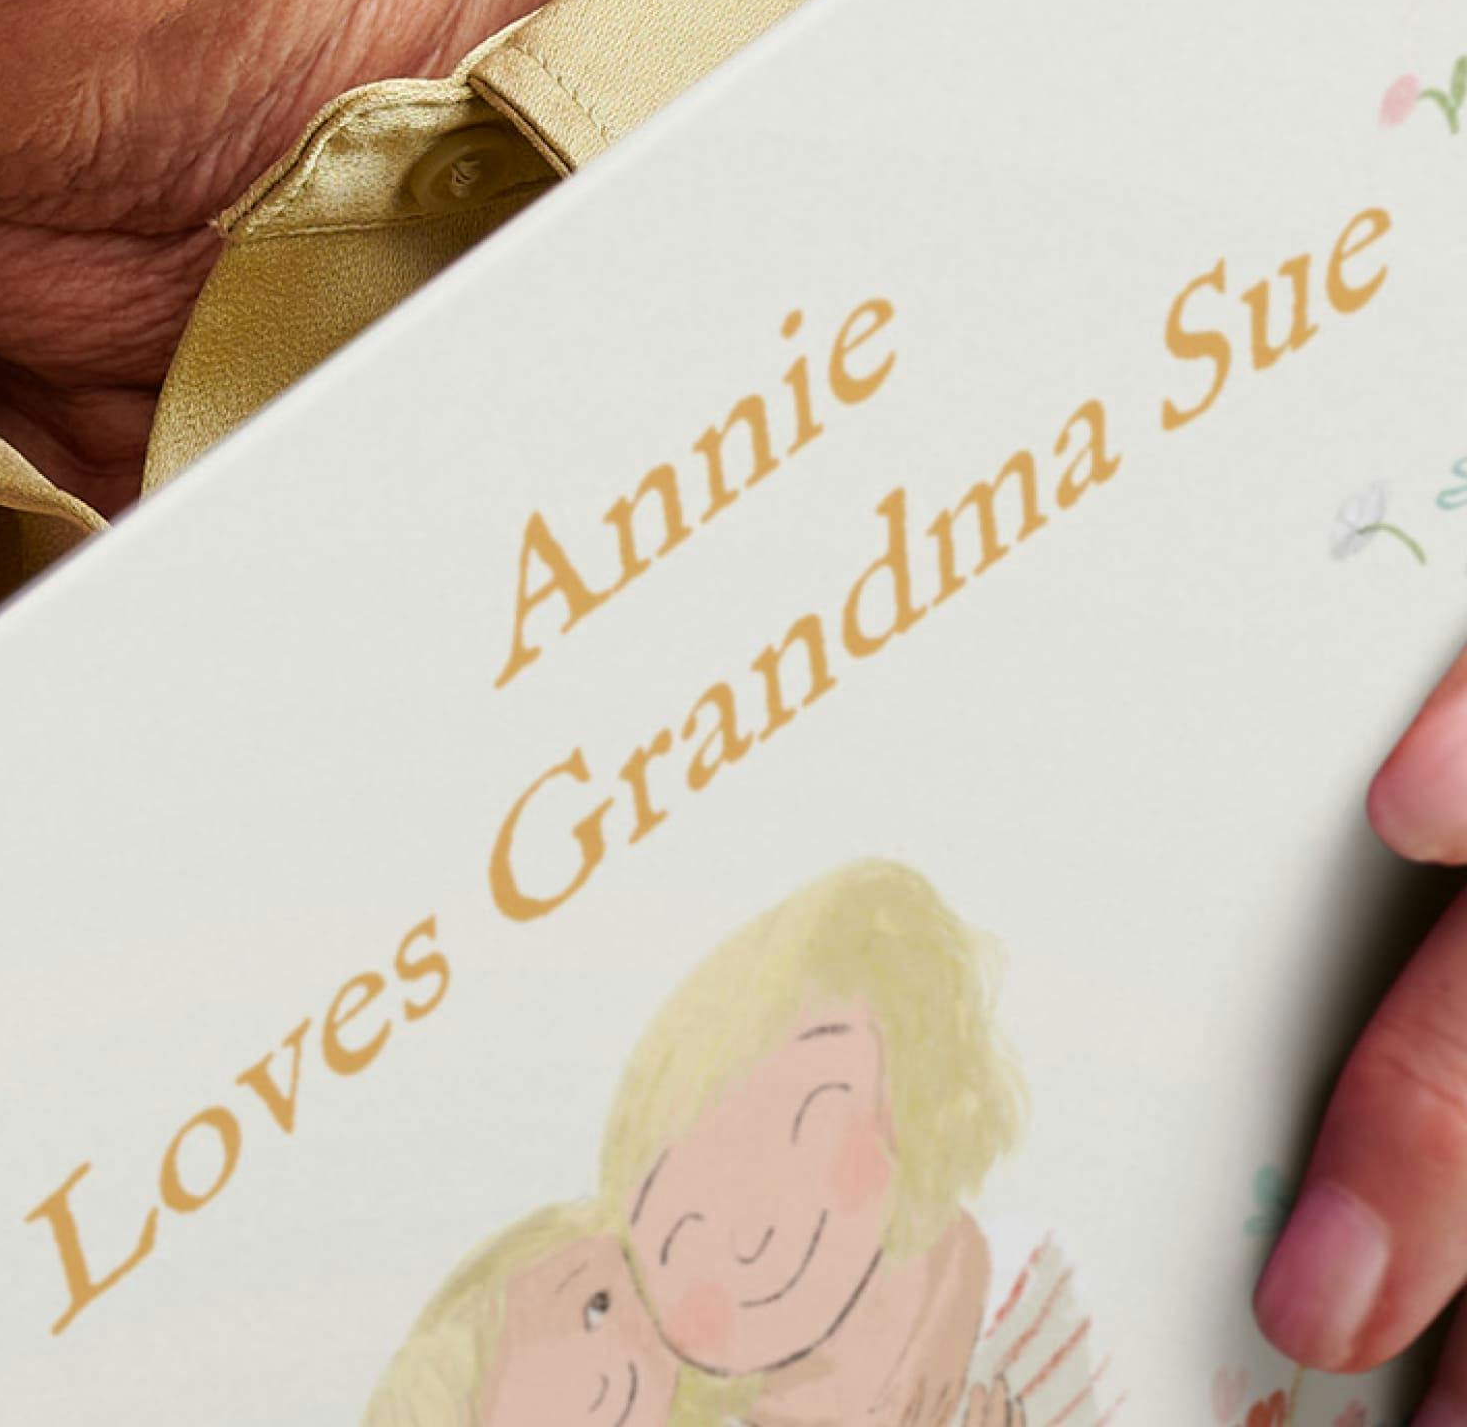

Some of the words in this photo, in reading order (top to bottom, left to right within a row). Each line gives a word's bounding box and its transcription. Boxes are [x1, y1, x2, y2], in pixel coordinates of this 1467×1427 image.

[24, 914, 452, 1337] Loves
[486, 397, 1123, 925] Grandma
[1159, 206, 1393, 433] Sue
[493, 297, 898, 692] Annie
